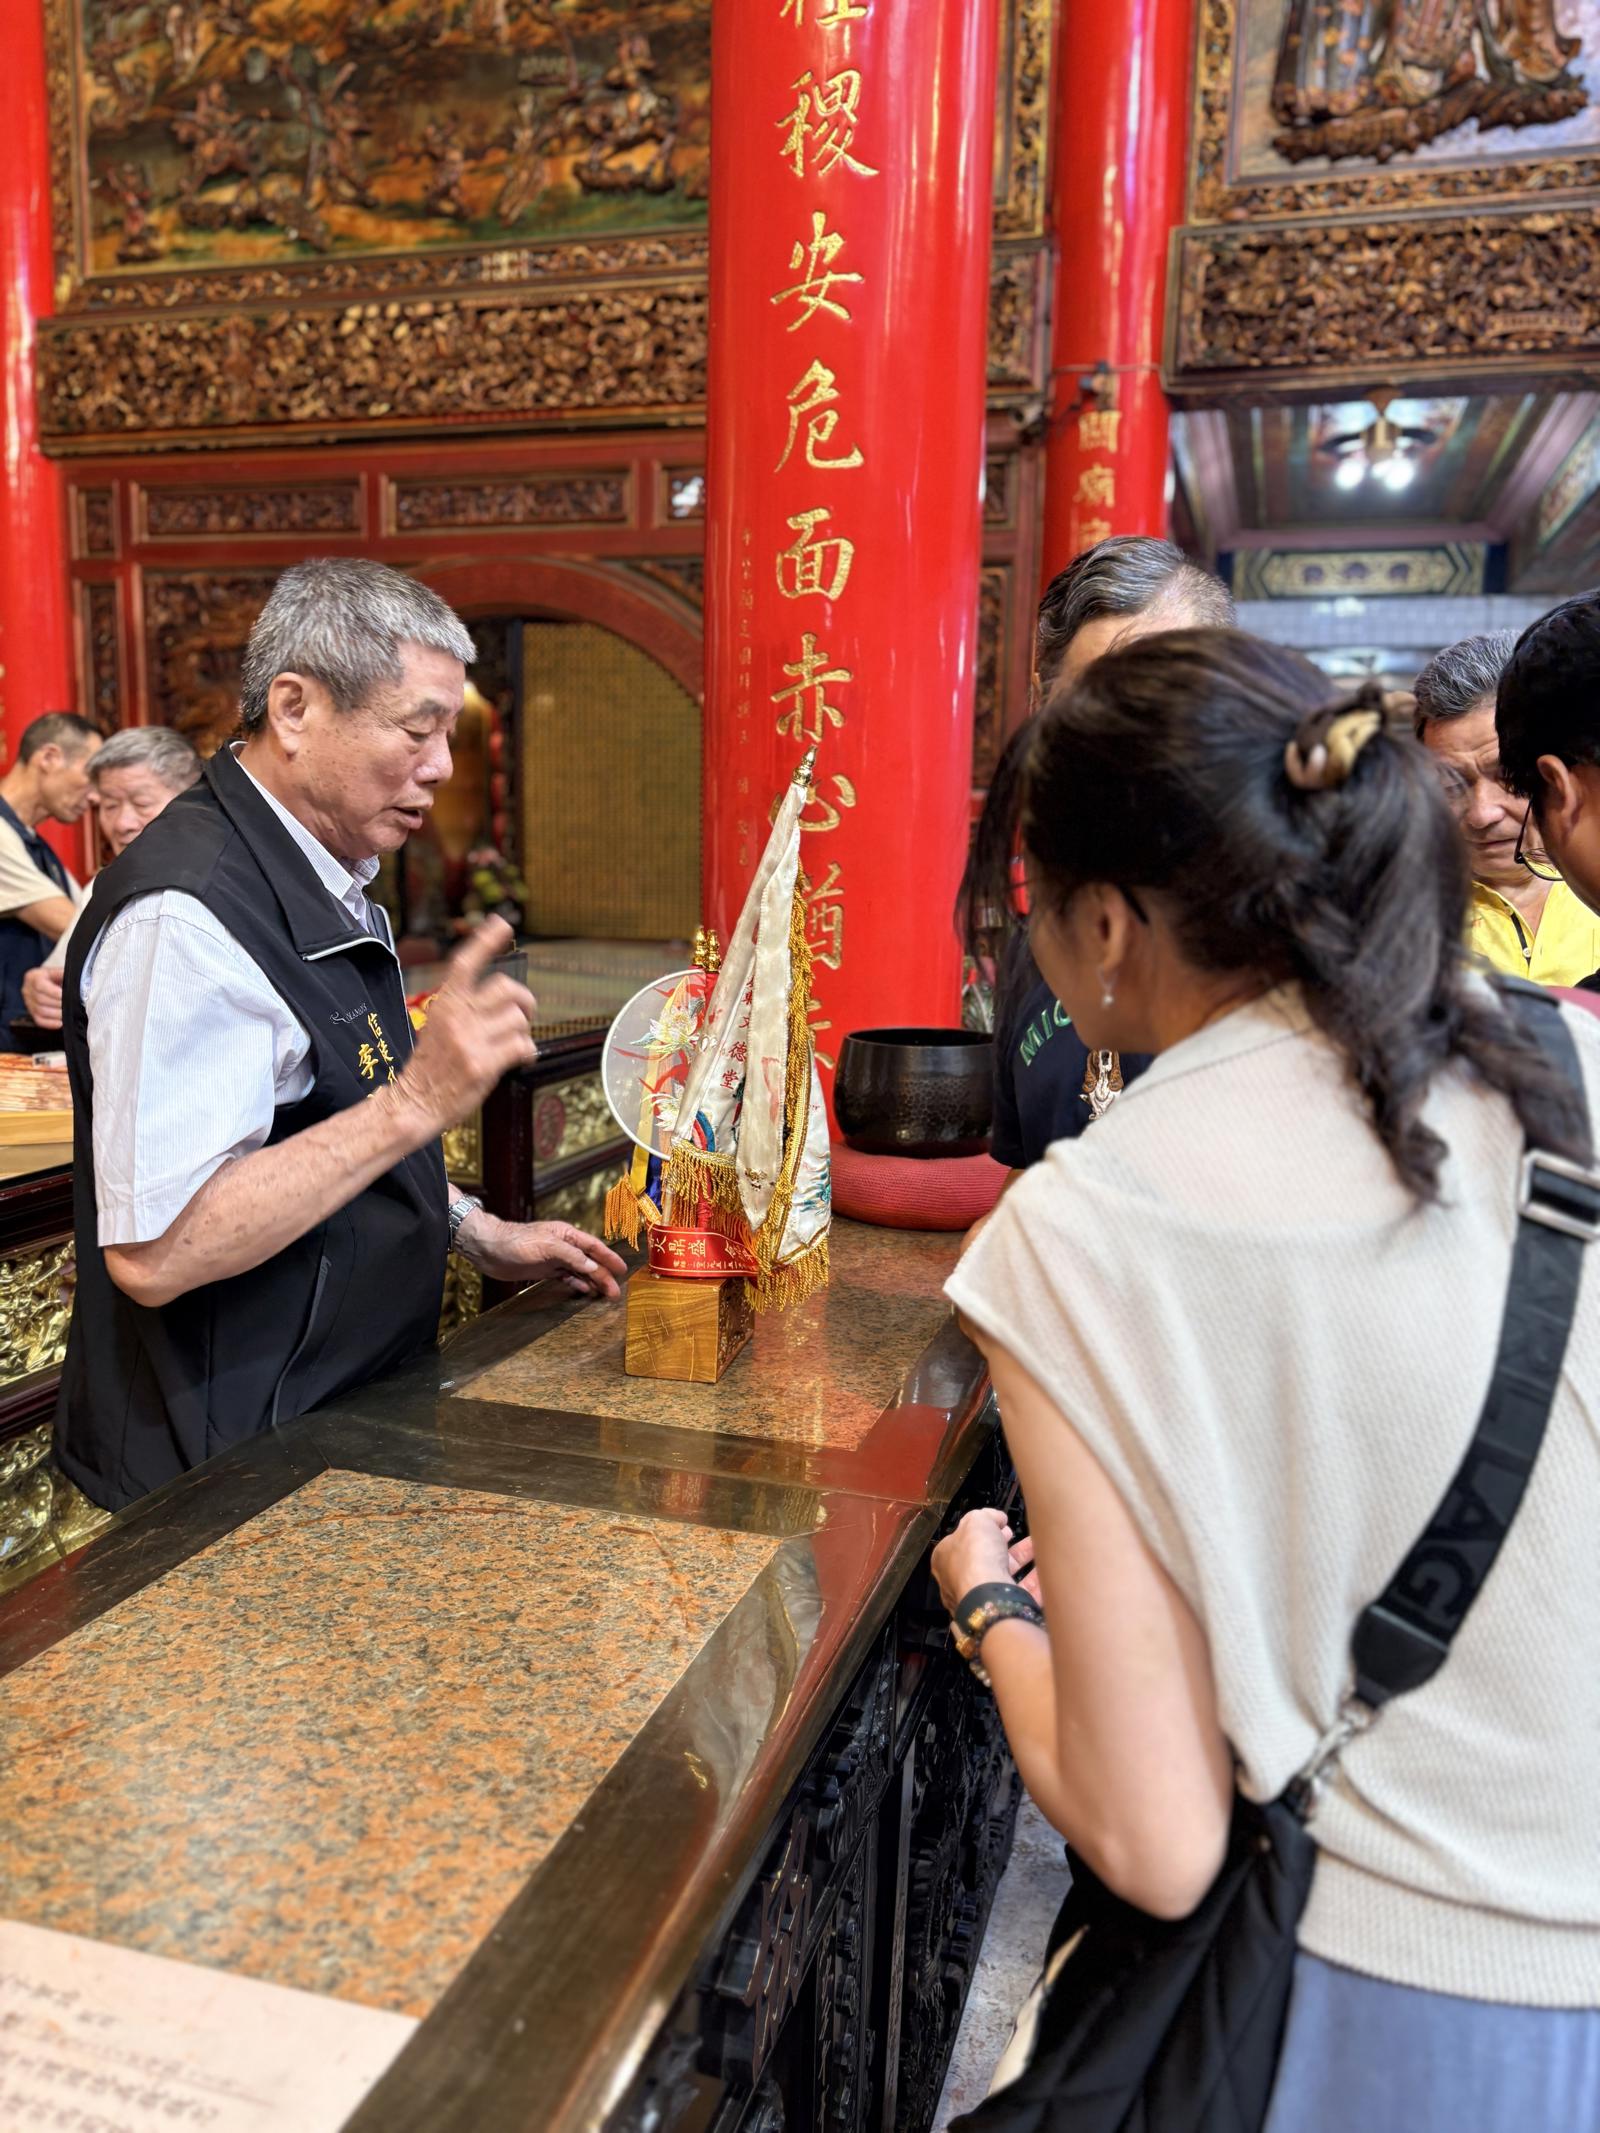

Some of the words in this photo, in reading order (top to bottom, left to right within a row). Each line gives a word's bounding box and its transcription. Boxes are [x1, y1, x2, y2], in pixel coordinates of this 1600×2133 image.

[770, 0, 879, 1070] 稷安危面赤心
[1379, 1440, 1533, 1645] LAG
